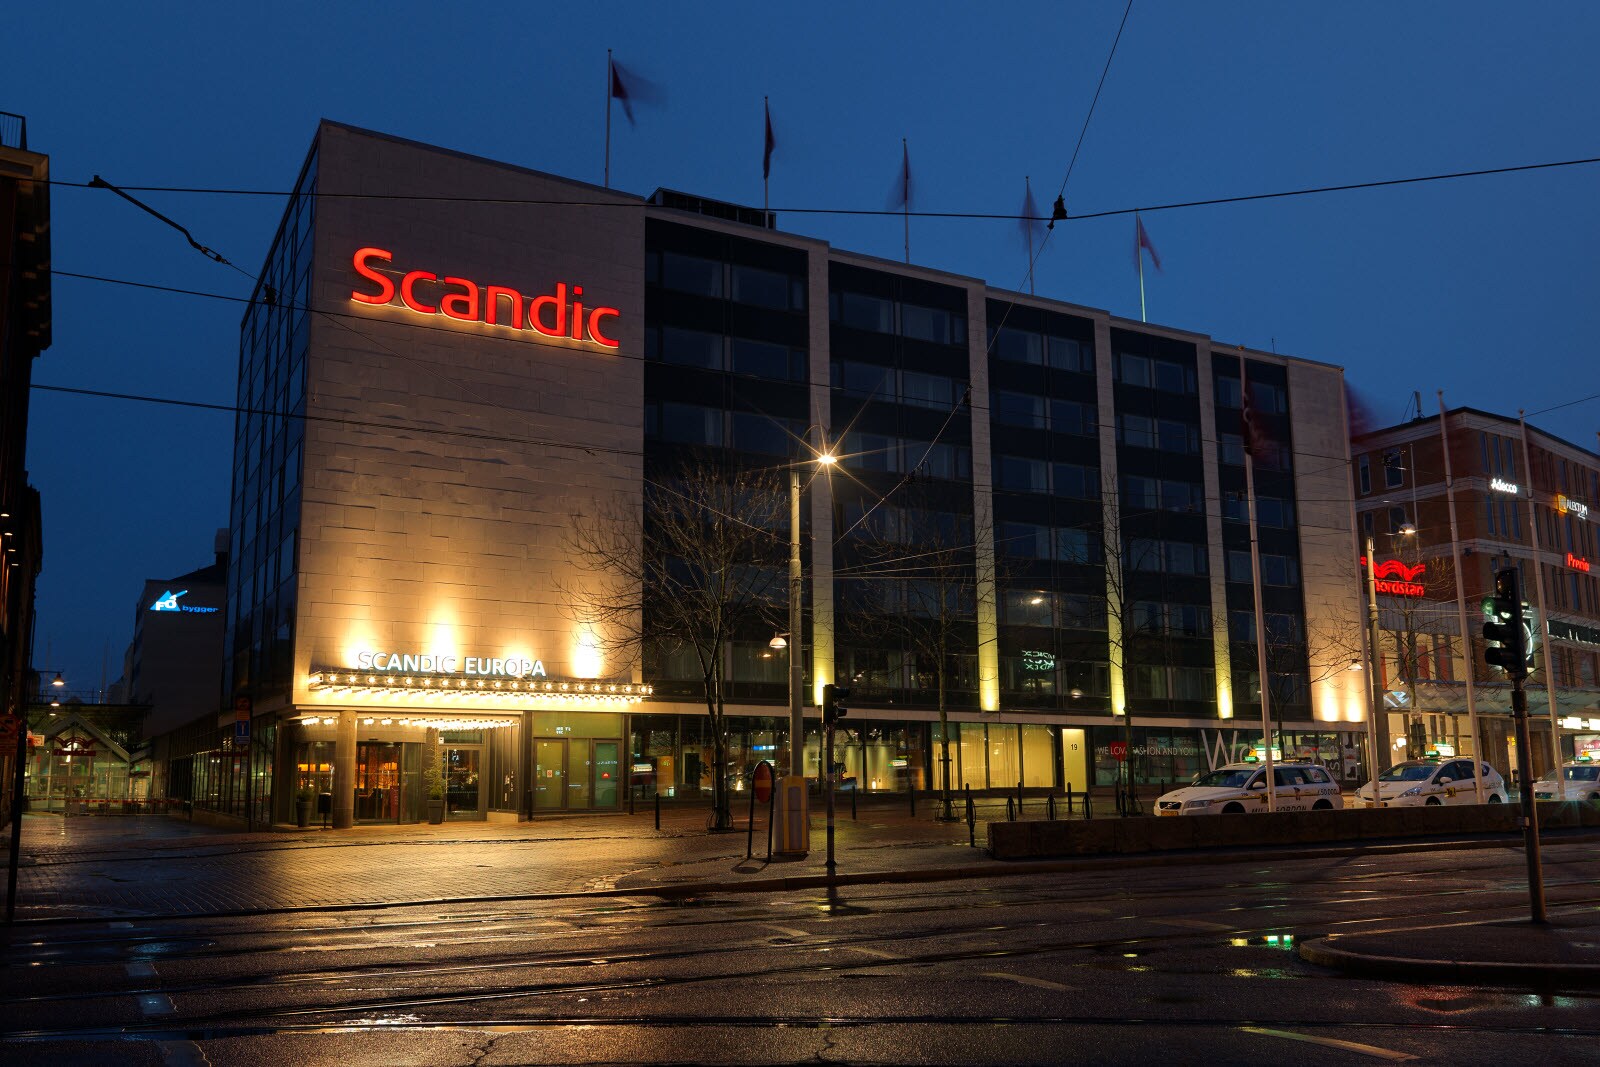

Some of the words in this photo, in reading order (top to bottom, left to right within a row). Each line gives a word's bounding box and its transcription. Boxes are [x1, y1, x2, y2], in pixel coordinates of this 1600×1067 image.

[350, 246, 620, 349] Scandic
[1490, 478, 1518, 494] Adecco
[182, 605, 219, 613] bygger
[356, 650, 456, 674] SCANDIC
[464, 656, 547, 677] EUROPA
[1070, 743, 1078, 751] 19
[1097, 746, 1109, 755] WE
[1110, 746, 1127, 756] LOV
[1162, 747, 1178, 756] AND
[1180, 747, 1194, 756] YOU
